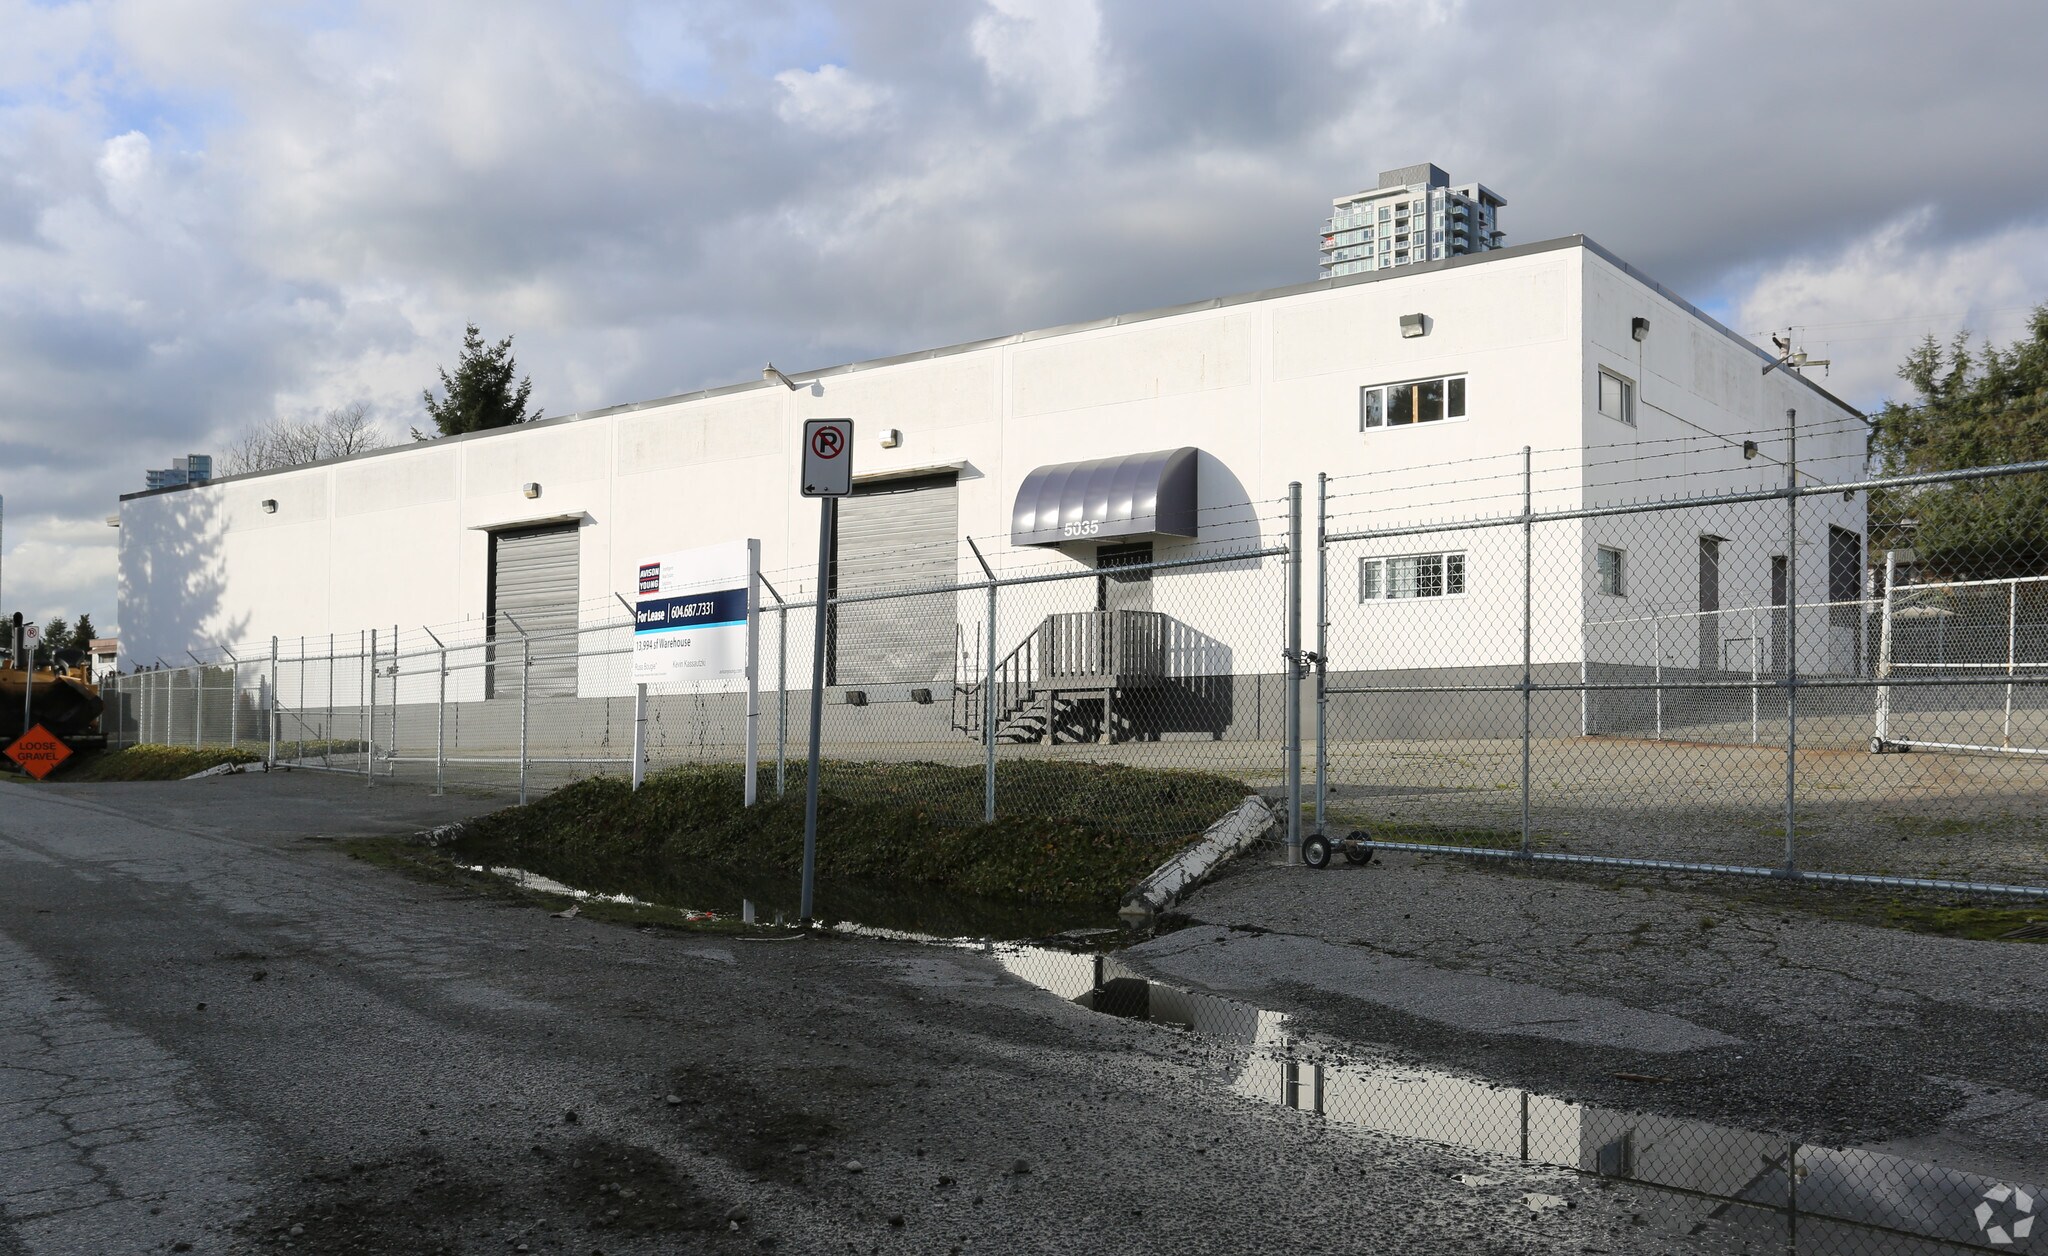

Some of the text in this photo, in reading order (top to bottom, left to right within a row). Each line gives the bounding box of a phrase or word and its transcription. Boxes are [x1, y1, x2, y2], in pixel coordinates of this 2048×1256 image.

[1064, 520, 1099, 536] 5035
[640, 567, 660, 577] AVISON
[640, 580, 659, 590] YOUNG
[637, 602, 714, 623] For Lease 604.687.7331
[636, 637, 691, 651] 13,994 sf Warehouse
[19, 742, 56, 750] LOOSE
[17, 752, 58, 761] GRAVEL
